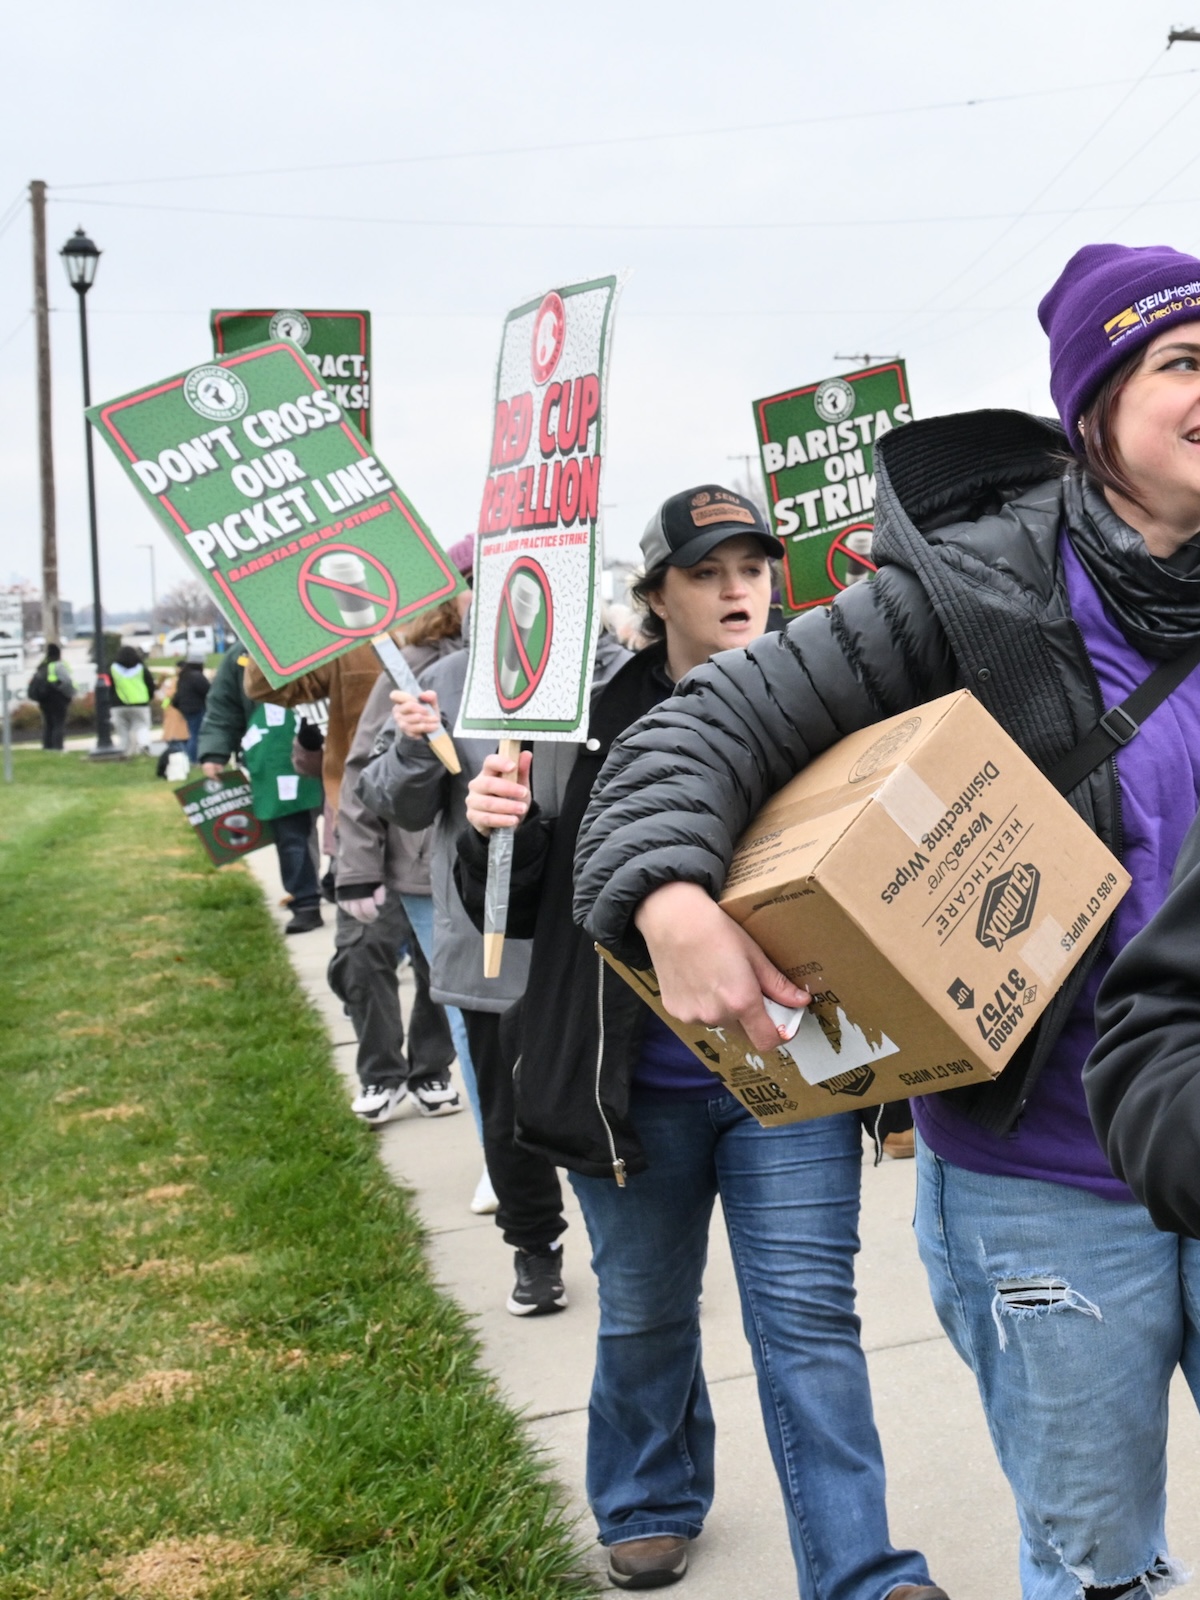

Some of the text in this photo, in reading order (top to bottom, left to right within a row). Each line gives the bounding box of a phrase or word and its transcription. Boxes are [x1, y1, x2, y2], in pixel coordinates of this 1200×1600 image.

[1145, 305, 1171, 325] United
[1170, 300, 1183, 313] for
[131, 389, 343, 496] DON'T CROSS
[489, 373, 599, 471] RED CUP
[762, 403, 913, 475] BARISTAS
[230, 448, 308, 499] OUR
[477, 454, 601, 538] REBELLION
[824, 449, 866, 484] ON
[184, 455, 394, 571] PICKET LINE
[519, 534, 559, 549] PRACTICE
[558, 532, 589, 546] STRIKE
[920, 759, 1001, 852] Disinfecting
[880, 850, 931, 905] Wipes
[984, 861, 1033, 953] CLOROX
[1059, 872, 1119, 952] 6/85 CT WIPES
[959, 987, 971, 1005] UP
[976, 967, 1027, 1041] 31757
[987, 1004, 1027, 1053] 44600
[897, 1058, 974, 1086] 6/85 CT WIPES
